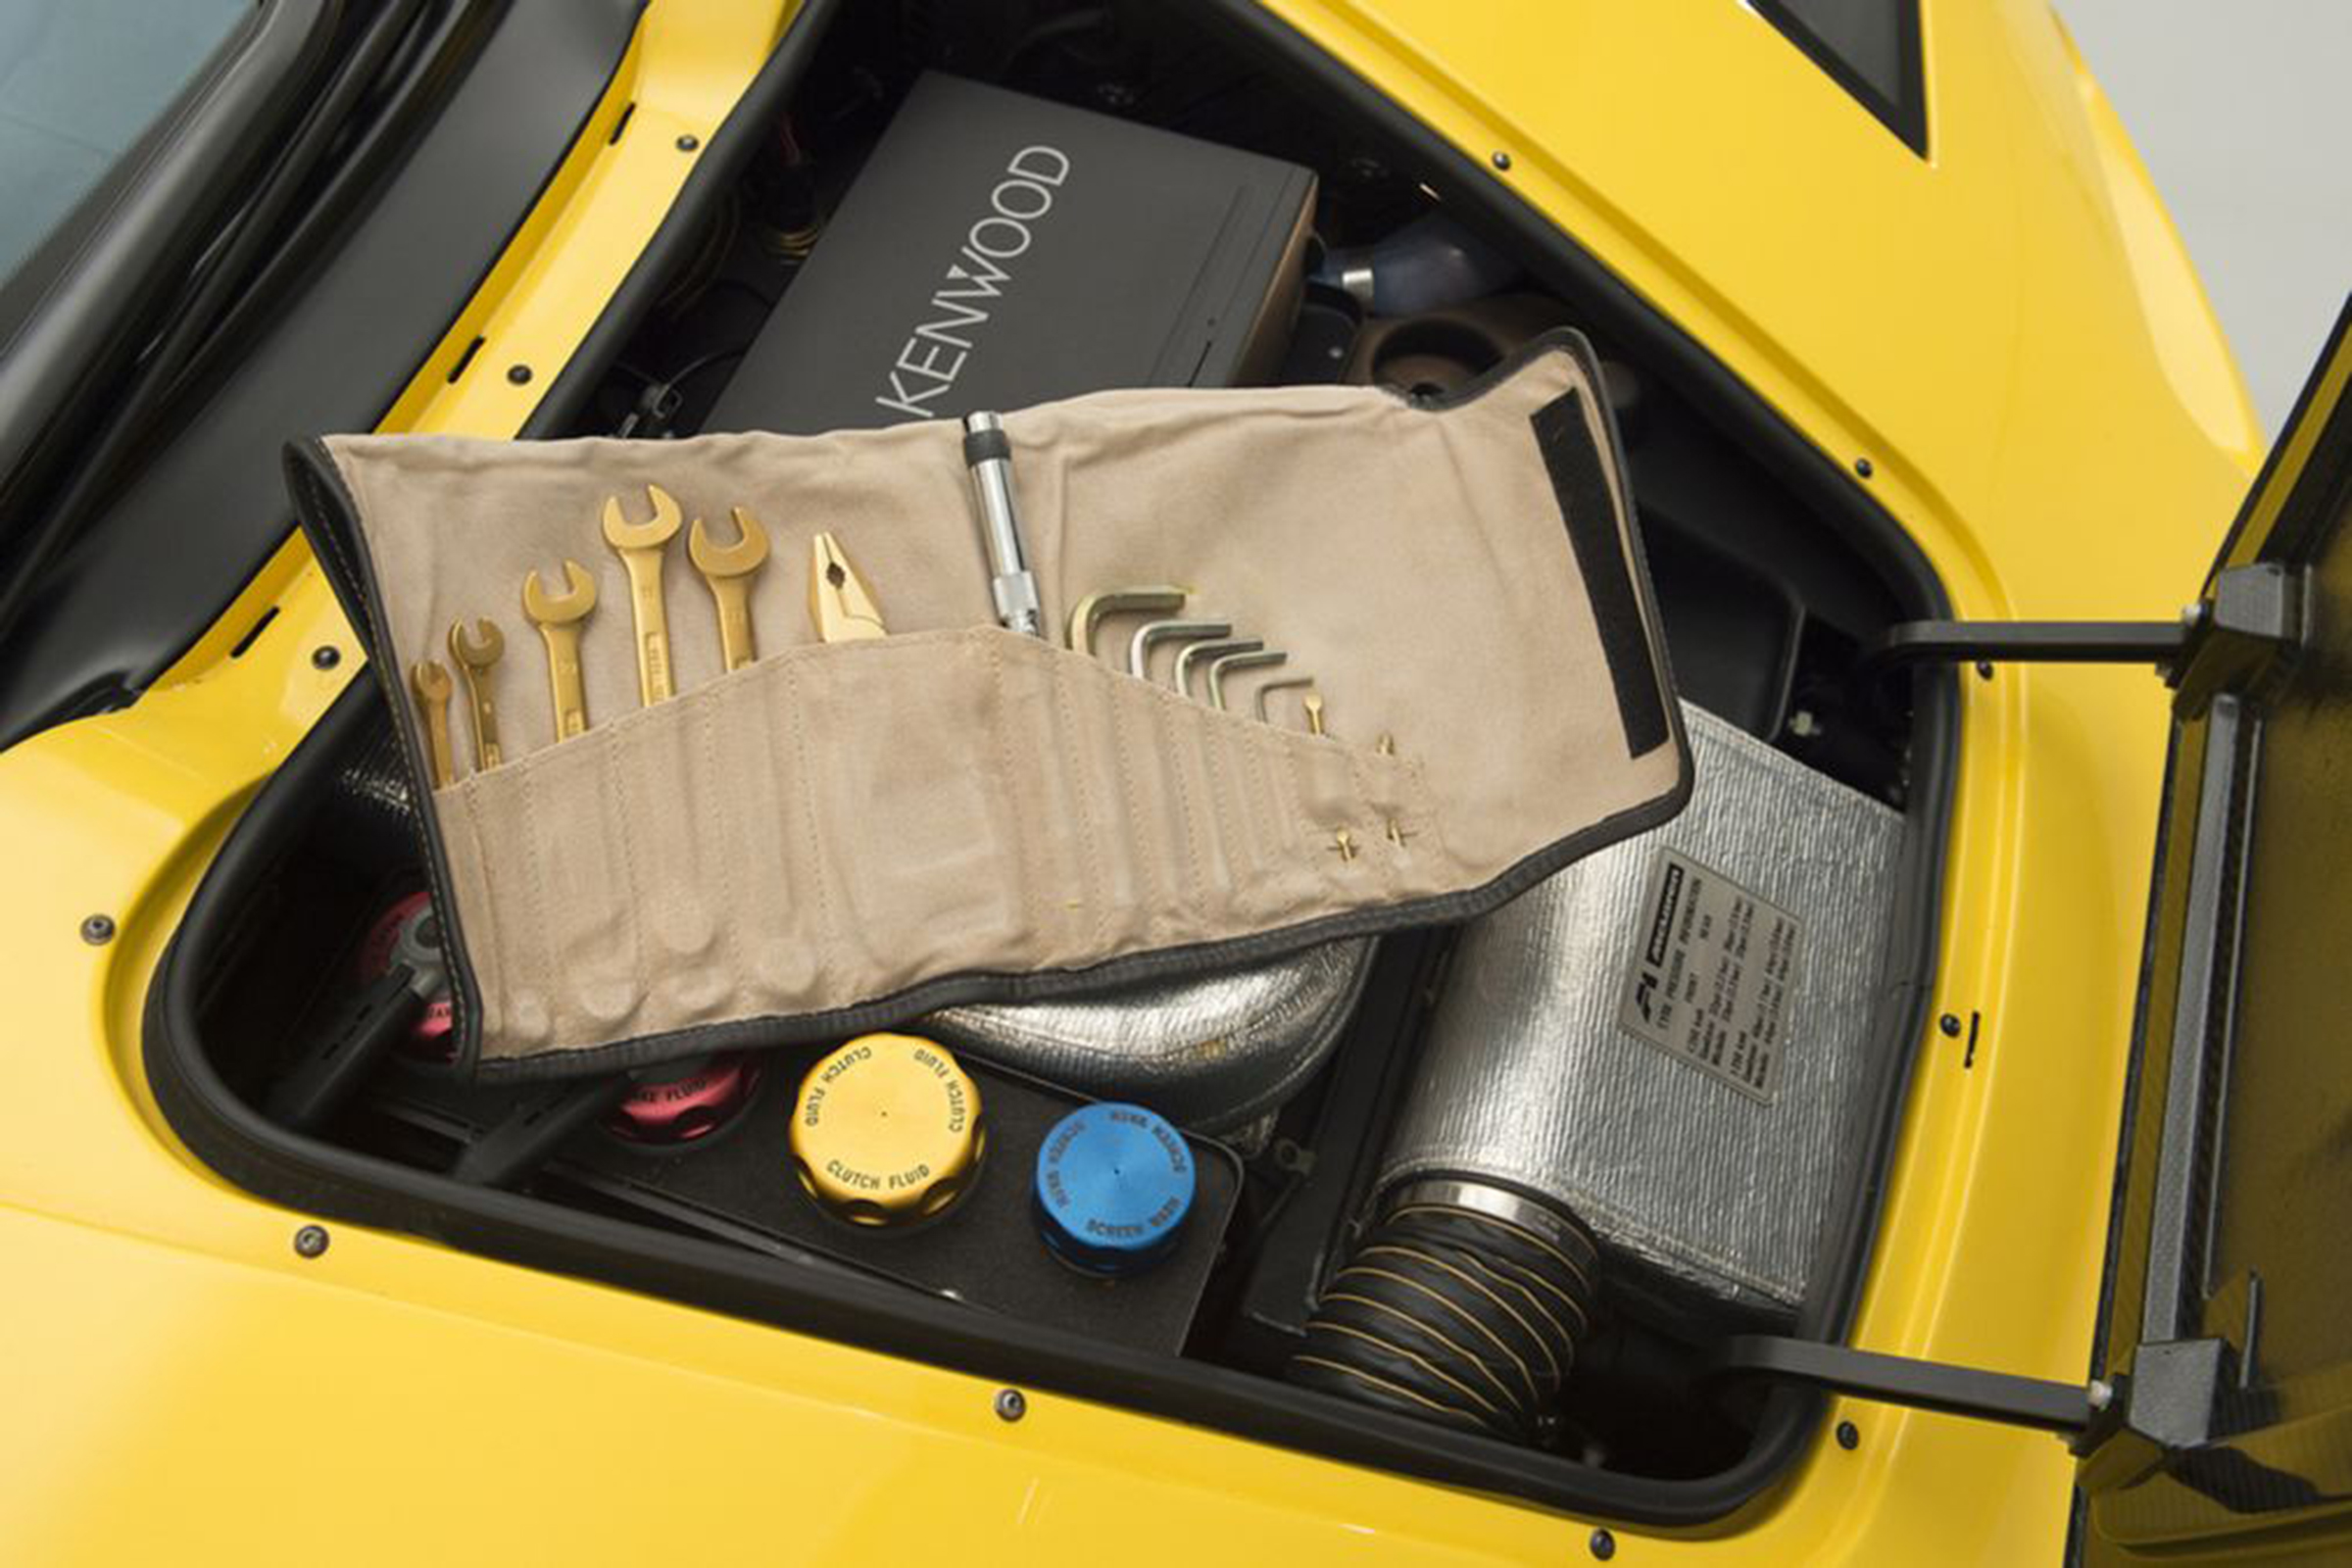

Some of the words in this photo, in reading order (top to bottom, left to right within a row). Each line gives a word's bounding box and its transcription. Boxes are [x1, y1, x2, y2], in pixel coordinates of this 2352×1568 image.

[876, 146, 1070, 417] KENWOOD
[821, 1046, 872, 1084] CLUTCH
[913, 1048, 950, 1079] FLUID
[805, 1087, 825, 1127] FLUID
[946, 1079, 966, 1133] CLUTCH
[826, 1159, 881, 1190] CLUTCH
[889, 1163, 930, 1190] FLUID
